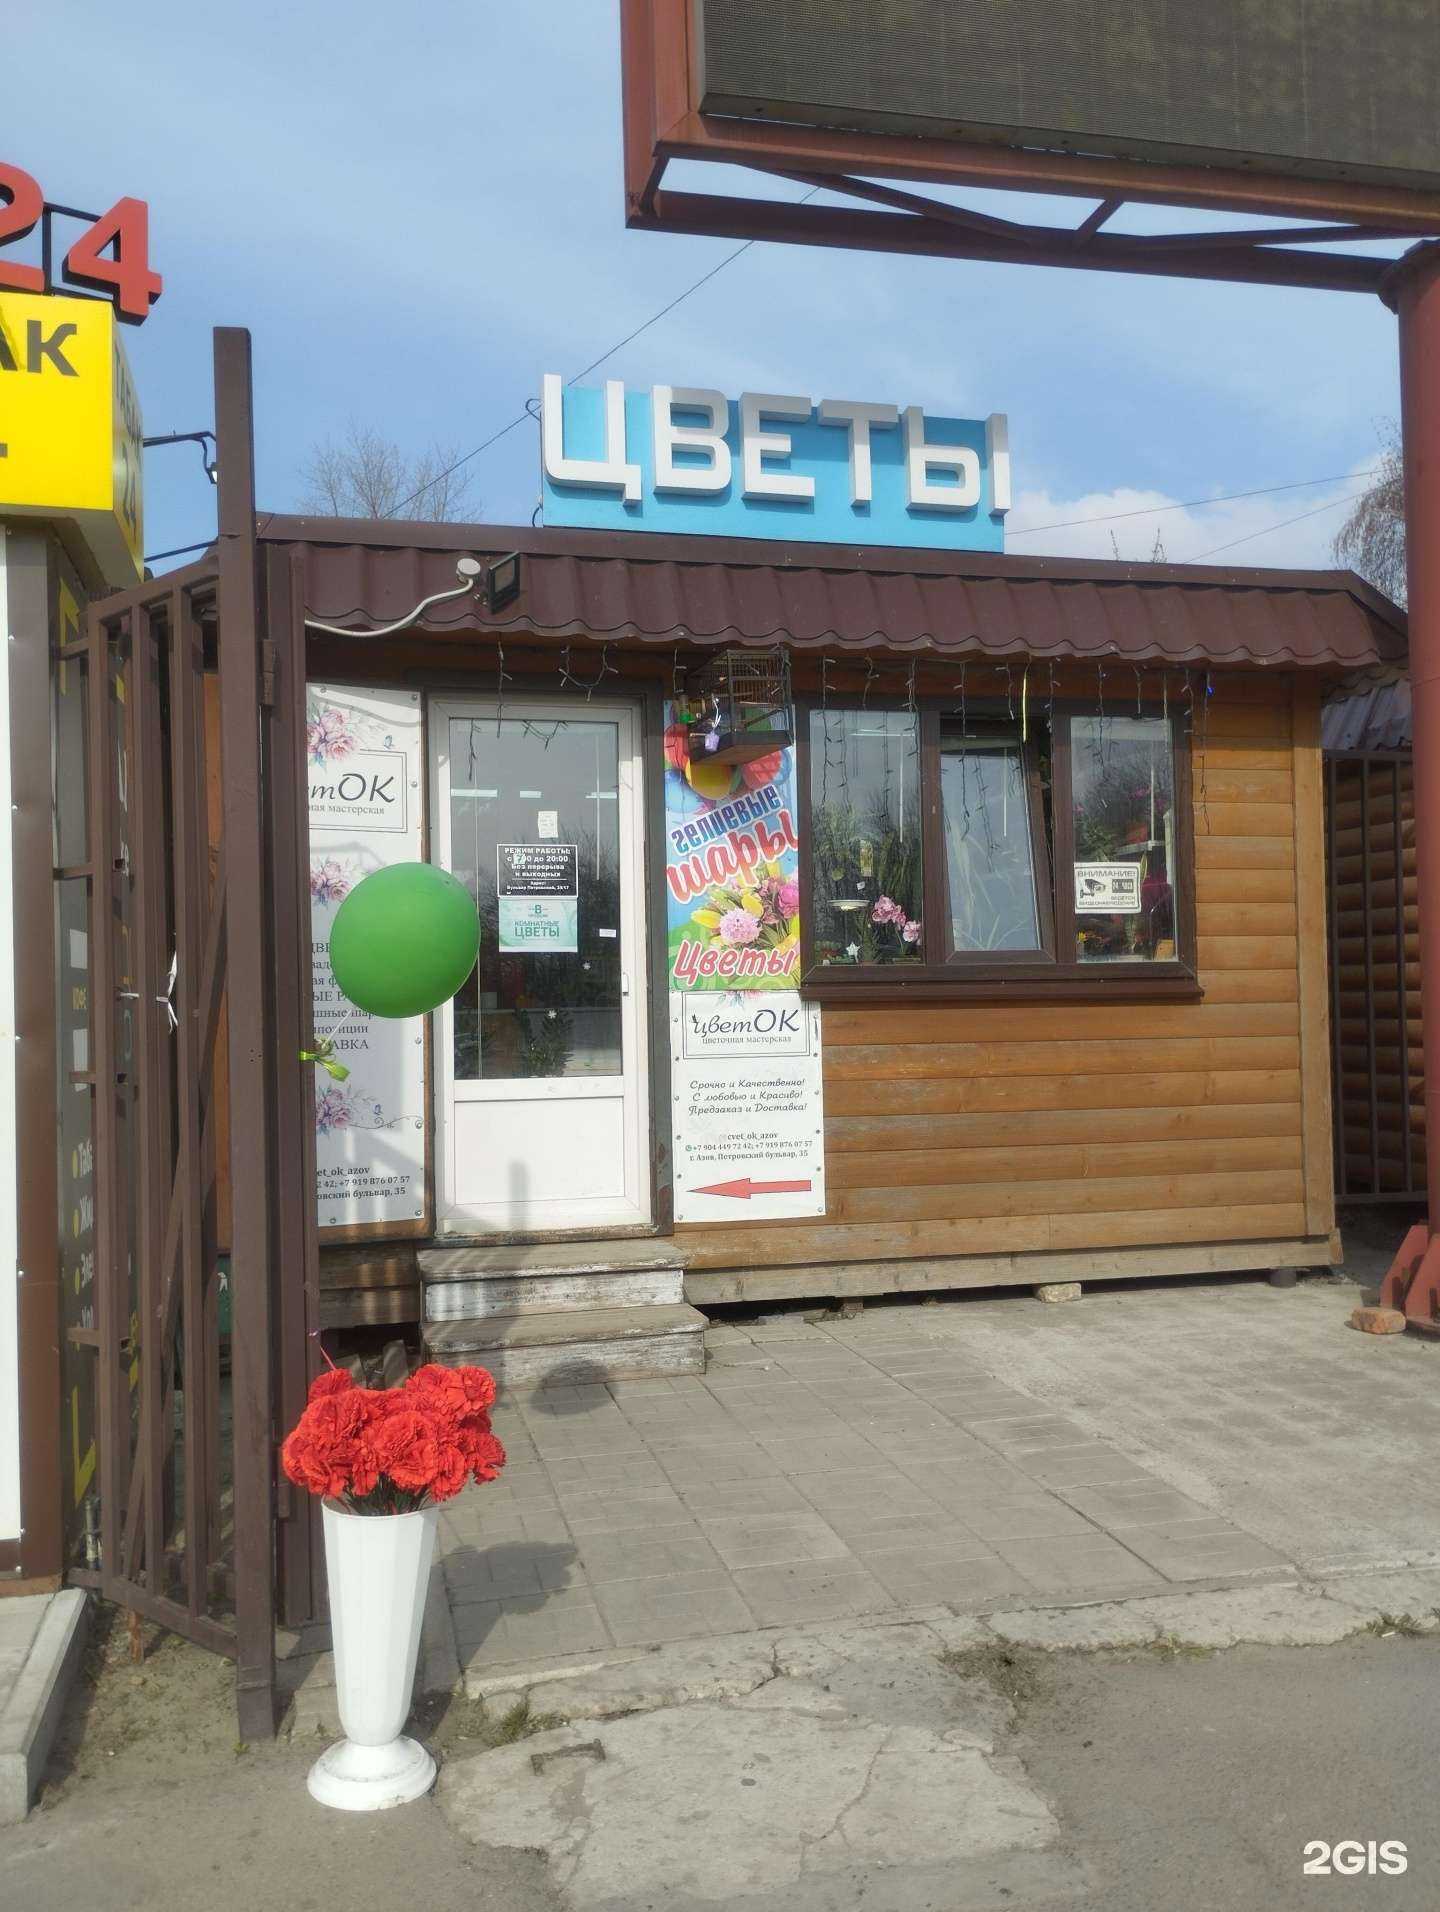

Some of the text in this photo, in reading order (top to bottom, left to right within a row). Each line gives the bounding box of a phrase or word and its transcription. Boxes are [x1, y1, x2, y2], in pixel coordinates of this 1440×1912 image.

[543, 374, 1011, 515] ЦВЕТЫ
[307, 773, 395, 803] тОК
[328, 805, 385, 815] мастерская
[668, 810, 799, 902] шары
[514, 926, 560, 939] ЦВЕТЫ
[674, 941, 796, 987] Цветы
[746, 1036, 792, 1044] мастерская
[690, 1080, 726, 1091] Срочно
[759, 1090, 803, 1100] Красиво!
[688, 1104, 743, 1116] Предзаказ
[755, 1103, 808, 1113] Доставка!
[718, 1151, 763, 1160] Петровский
[394, 1187, 406, 1195] 35
